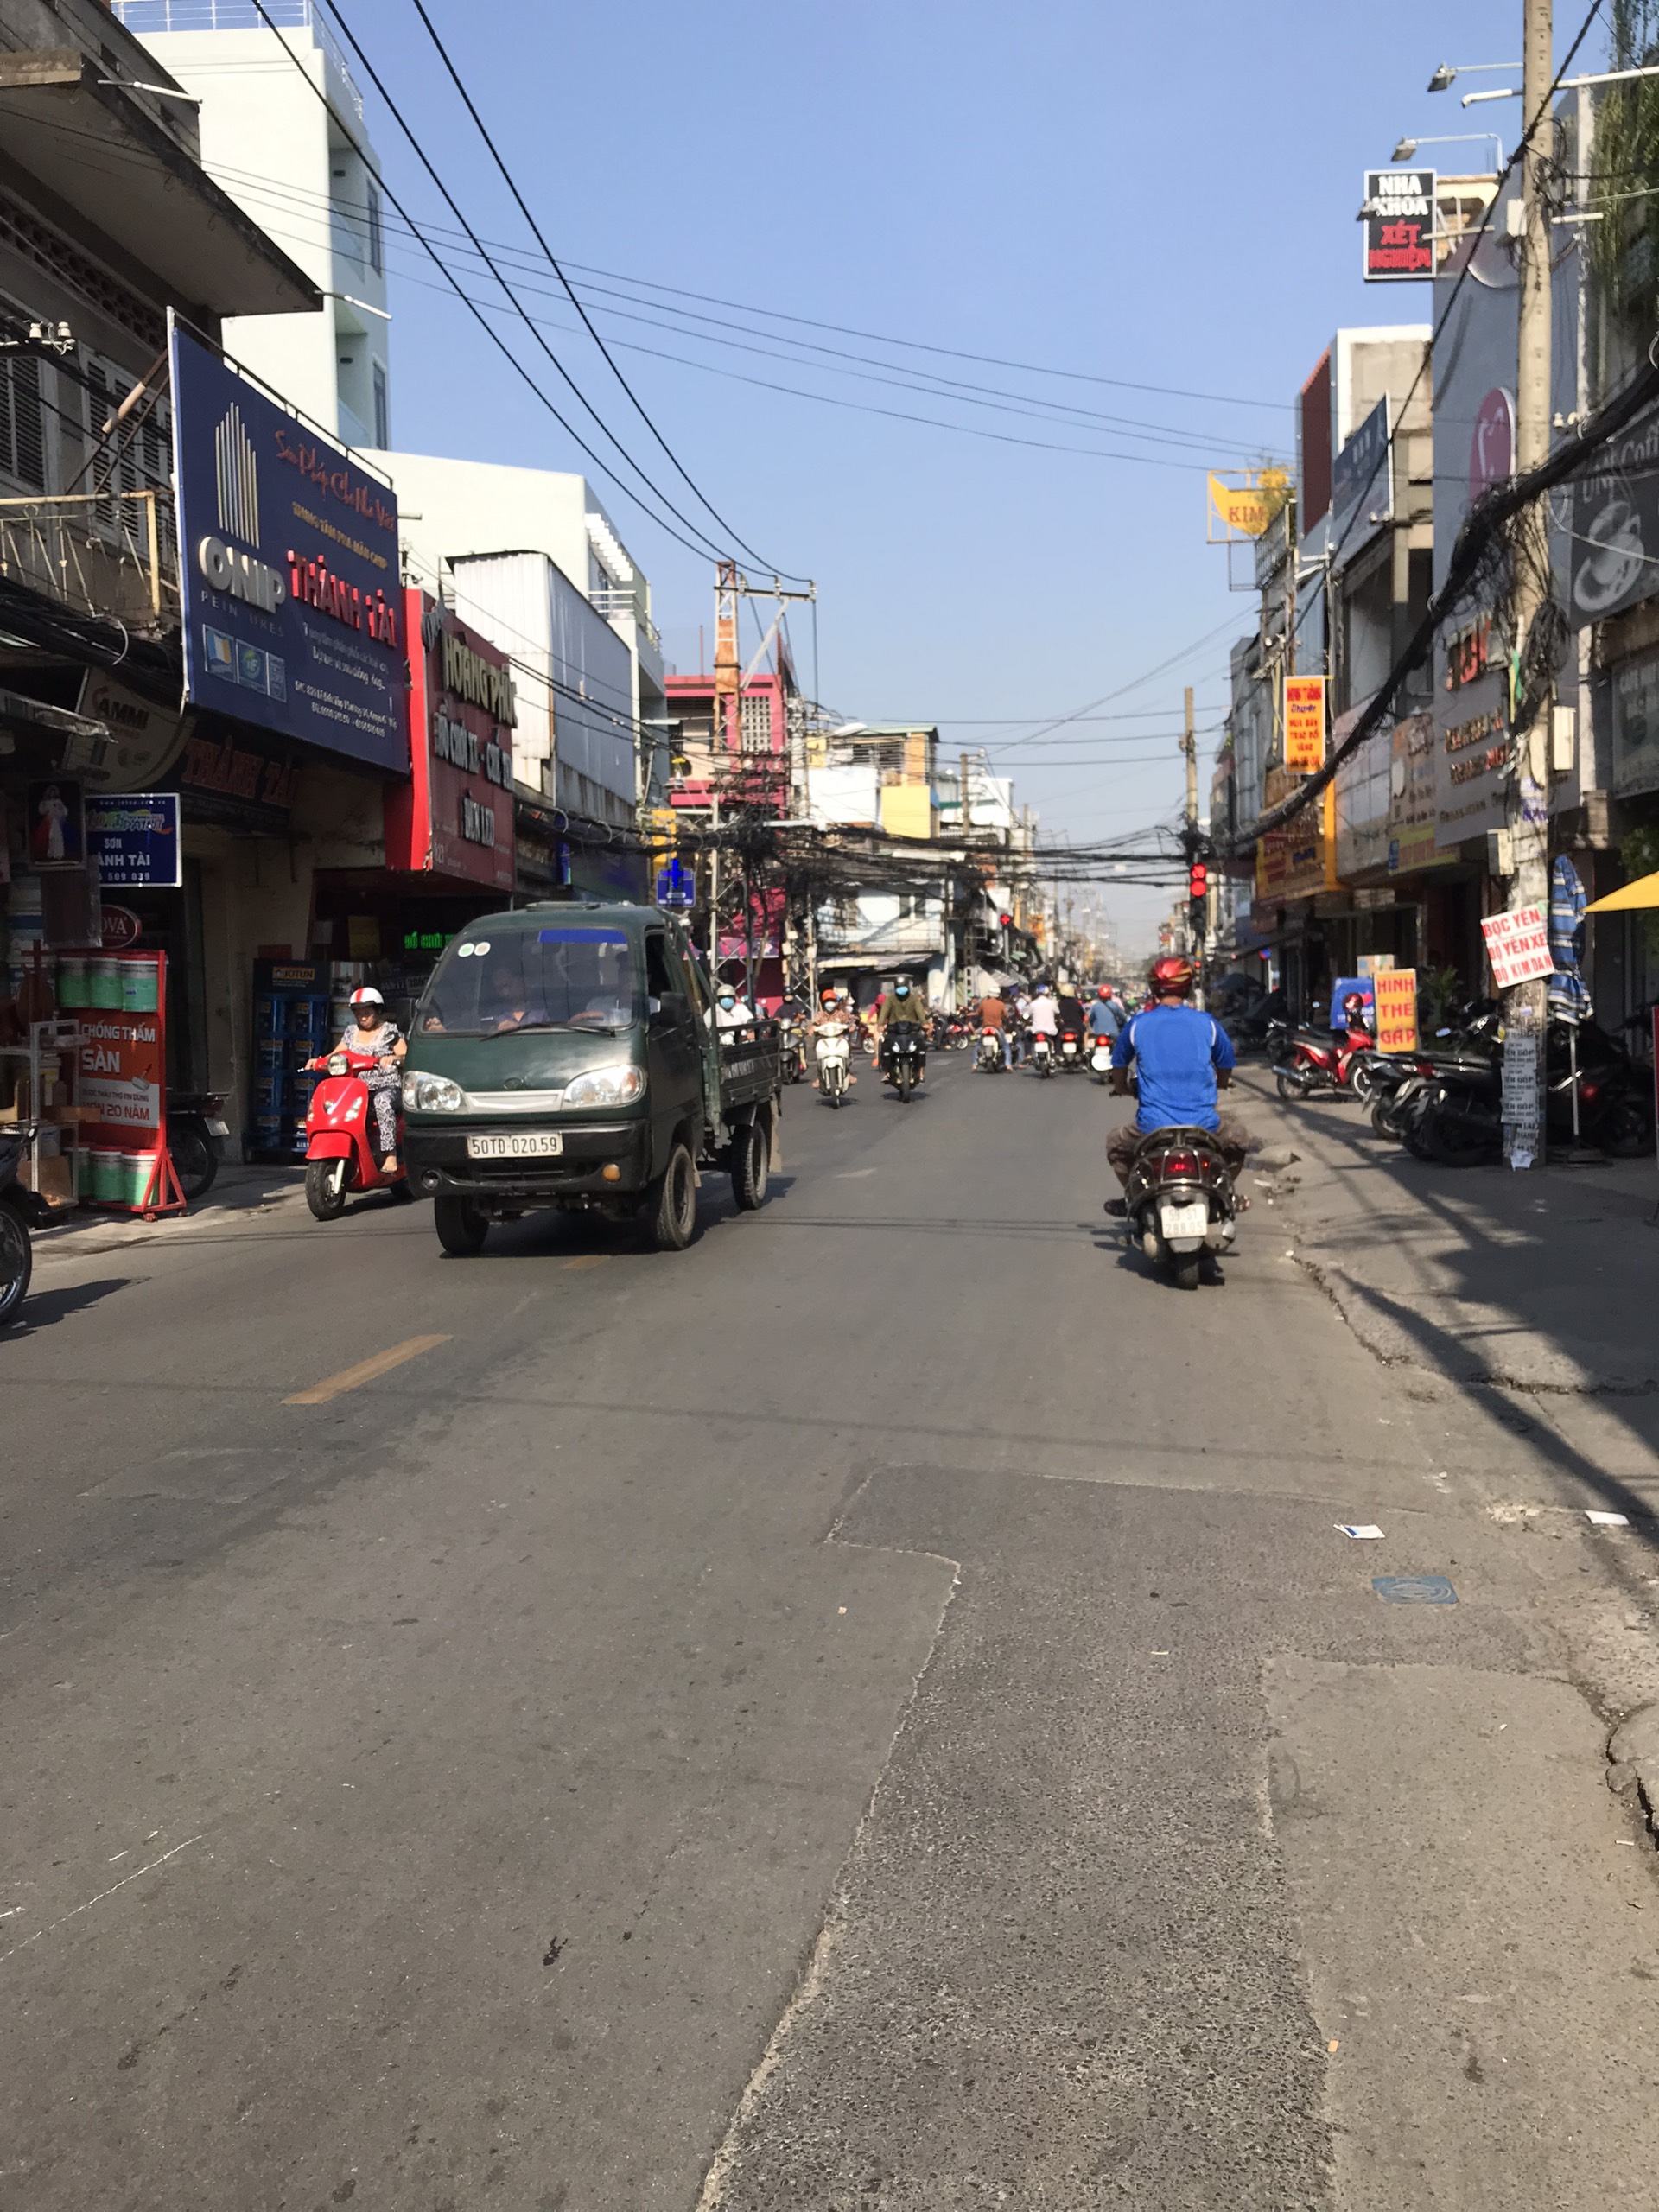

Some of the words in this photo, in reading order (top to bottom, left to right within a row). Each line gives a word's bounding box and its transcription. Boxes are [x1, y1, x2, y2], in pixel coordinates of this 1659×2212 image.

[1378, 175, 1422, 195] NHA
[1228, 506, 1265, 523] KIM
[198, 536, 286, 614] ONIP
[442, 629, 488, 710] HOÀNG
[128, 851, 150, 866] TÀI
[1481, 918, 1510, 938] BỌC
[1513, 909, 1541, 929] YÊN
[1503, 937, 1530, 957] YÊN
[1529, 932, 1547, 949] XE
[1510, 959, 1531, 977] KIM
[1380, 998, 1414, 1019] THẺ
[122, 1021, 156, 1042] THẤM
[1380, 1024, 1415, 1045] GẤP
[82, 1044, 121, 1074] SÀN
[106, 1104, 122, 1117] 20
[124, 1103, 149, 1120] NĂM
